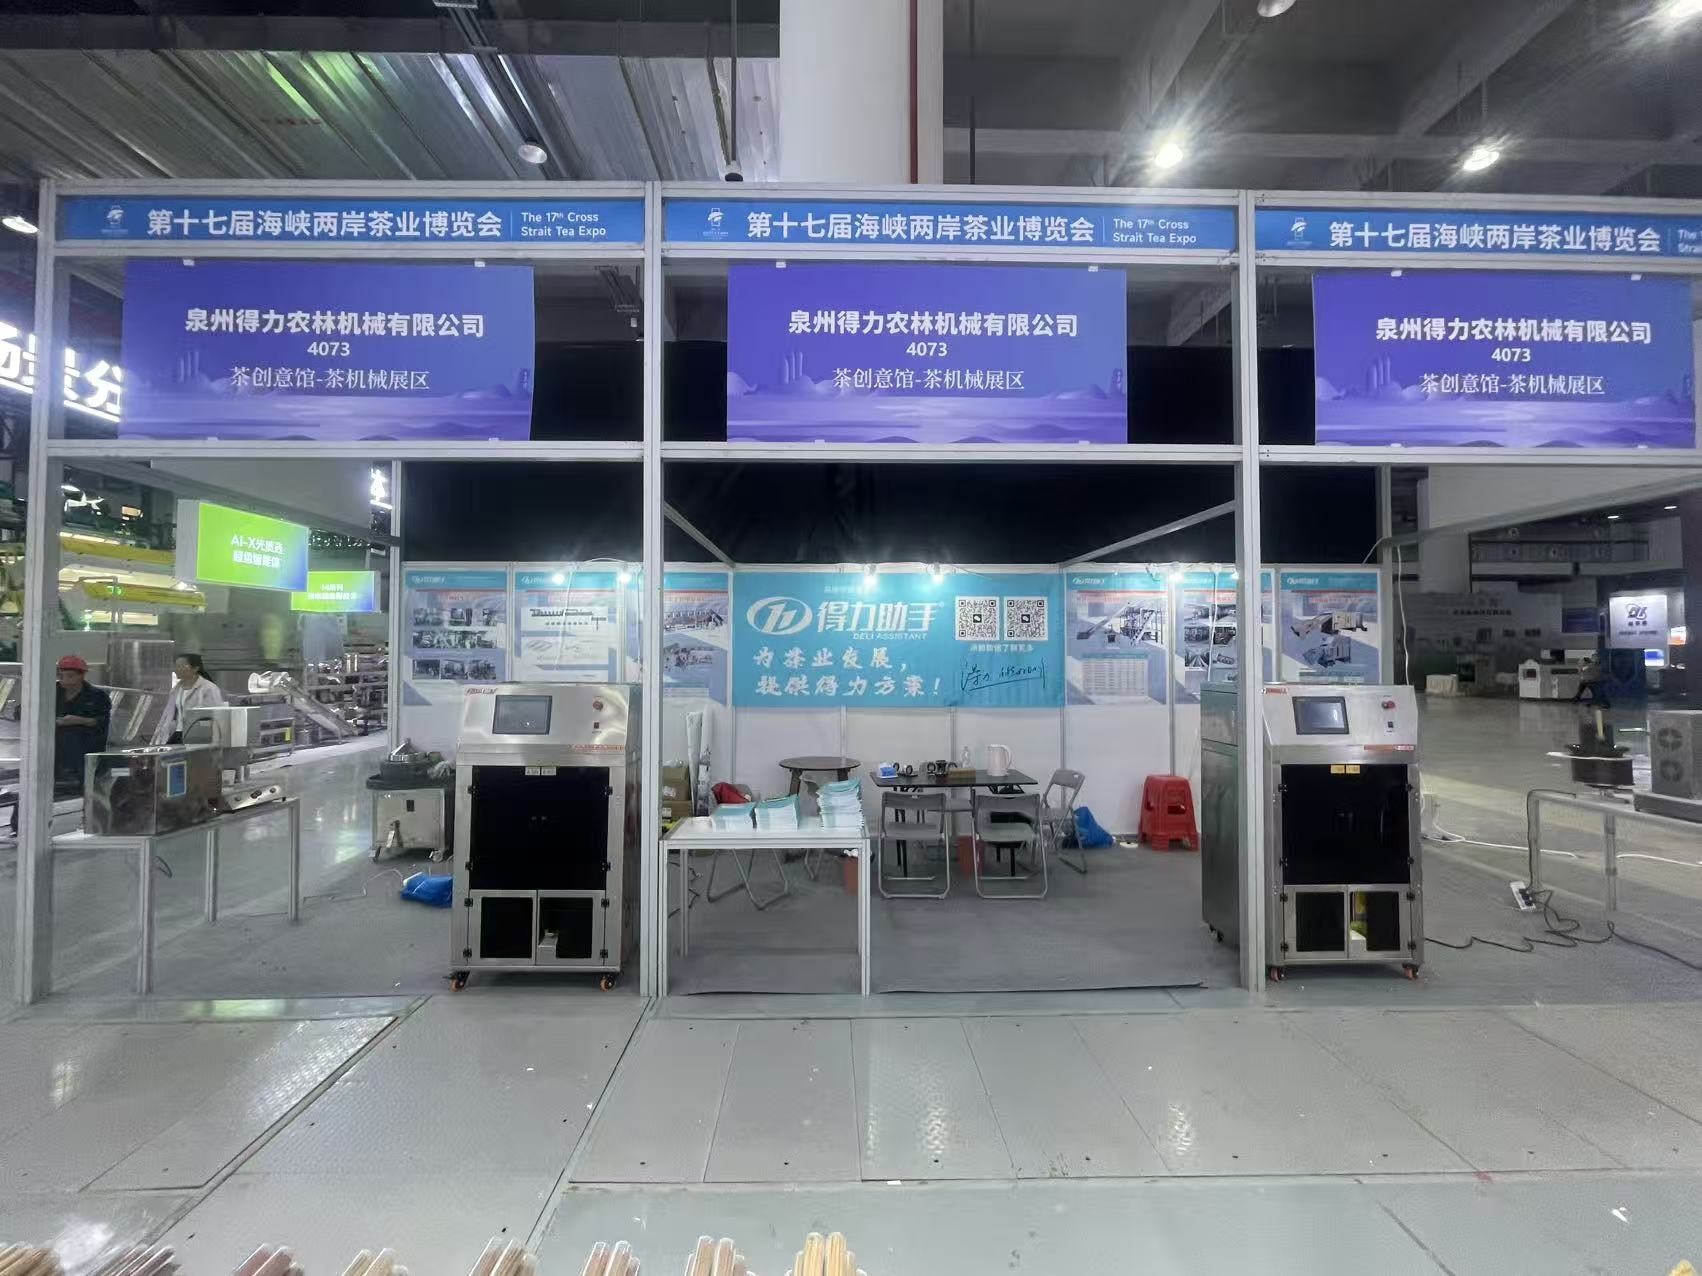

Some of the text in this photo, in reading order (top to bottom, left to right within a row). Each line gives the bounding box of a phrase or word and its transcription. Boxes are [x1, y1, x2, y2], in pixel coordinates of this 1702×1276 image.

[147, 208, 503, 238] 第十七届海峡两岸茶业博览会
[521, 212, 542, 222] The
[567, 212, 599, 222] Cross
[746, 211, 1096, 243] 第十七届海峡两岸茶业博览会
[1113, 218, 1134, 229] The
[1158, 219, 1189, 230] Cross
[521, 226, 607, 238] Strait Tea Expo
[1113, 232, 1197, 245] Strait Tea Expo
[1328, 220, 1661, 253] 第十七届海峡两岸茶业博览会
[185, 308, 484, 338] 泉州得力农林机械有限公司
[788, 309, 1078, 337] 泉州得力农林机械有限公司
[1375, 317, 1652, 344] 泉州得力农林机械有限公司
[306, 341, 351, 357] 4073
[906, 341, 948, 357] 4073
[1491, 347, 1531, 362] 4073
[230, 366, 431, 391] 茶创意馆-茶机械展区
[832, 367, 1025, 391] 茶创意馆-茶机械展区
[1420, 373, 1605, 396] 茶创意馆-茶机械展区
[817, 601, 938, 632] 得力助手
[853, 632, 874, 640] DELI
